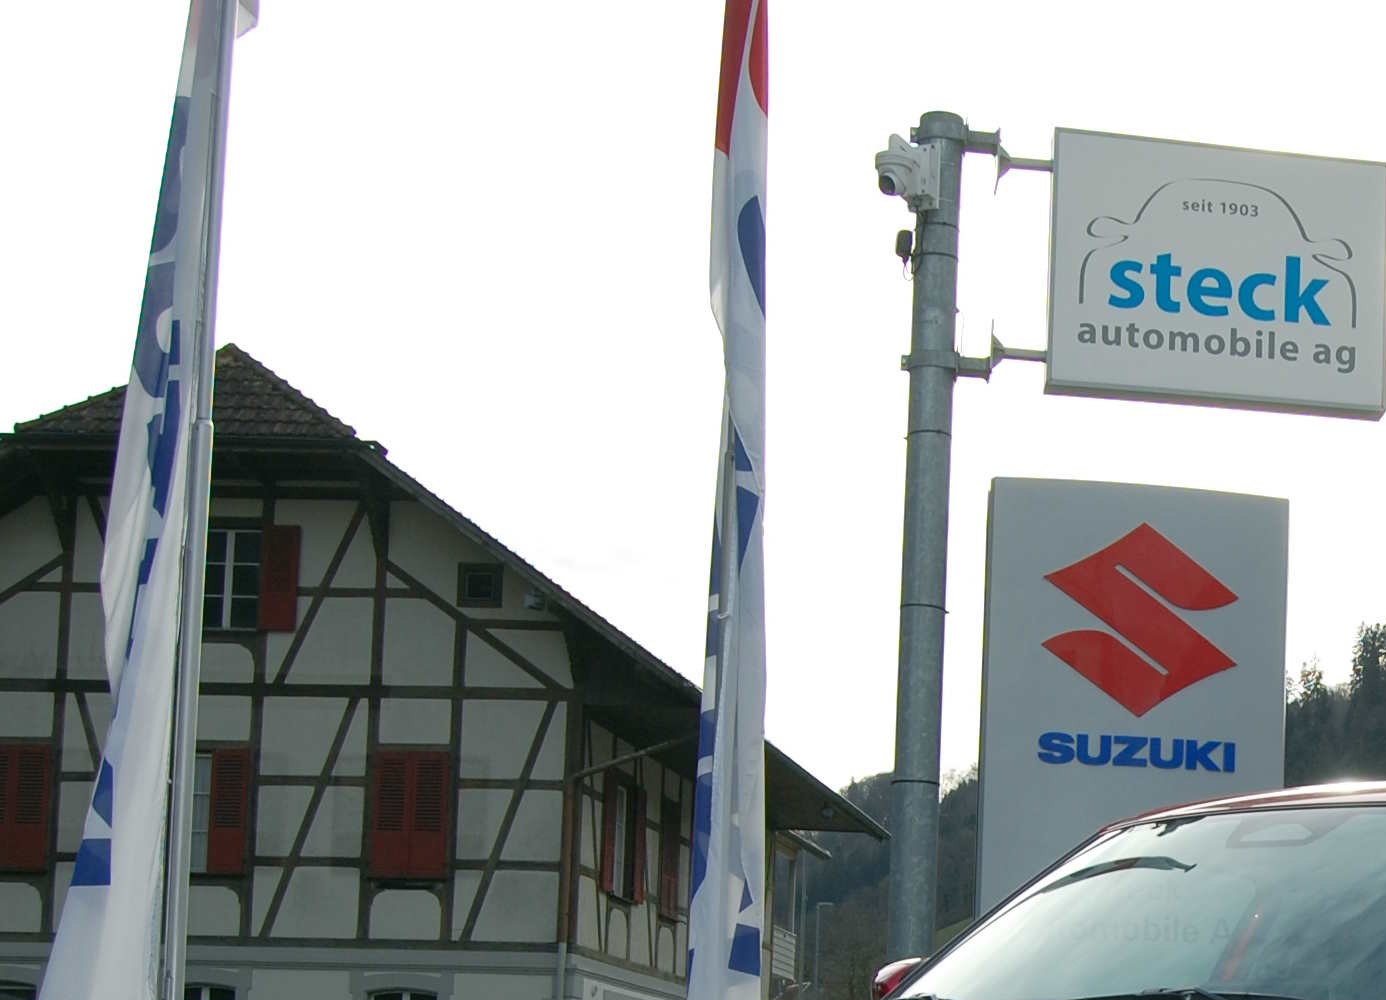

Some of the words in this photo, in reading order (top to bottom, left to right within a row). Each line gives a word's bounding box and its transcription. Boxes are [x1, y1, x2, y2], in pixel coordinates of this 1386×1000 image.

[1181, 199, 1213, 214] seit
[1220, 201, 1260, 218] 1903
[1108, 252, 1332, 327] steck
[1077, 321, 1300, 363] automobile
[1312, 342, 1357, 375] ag
[1038, 731, 1237, 773] SUZUKI
